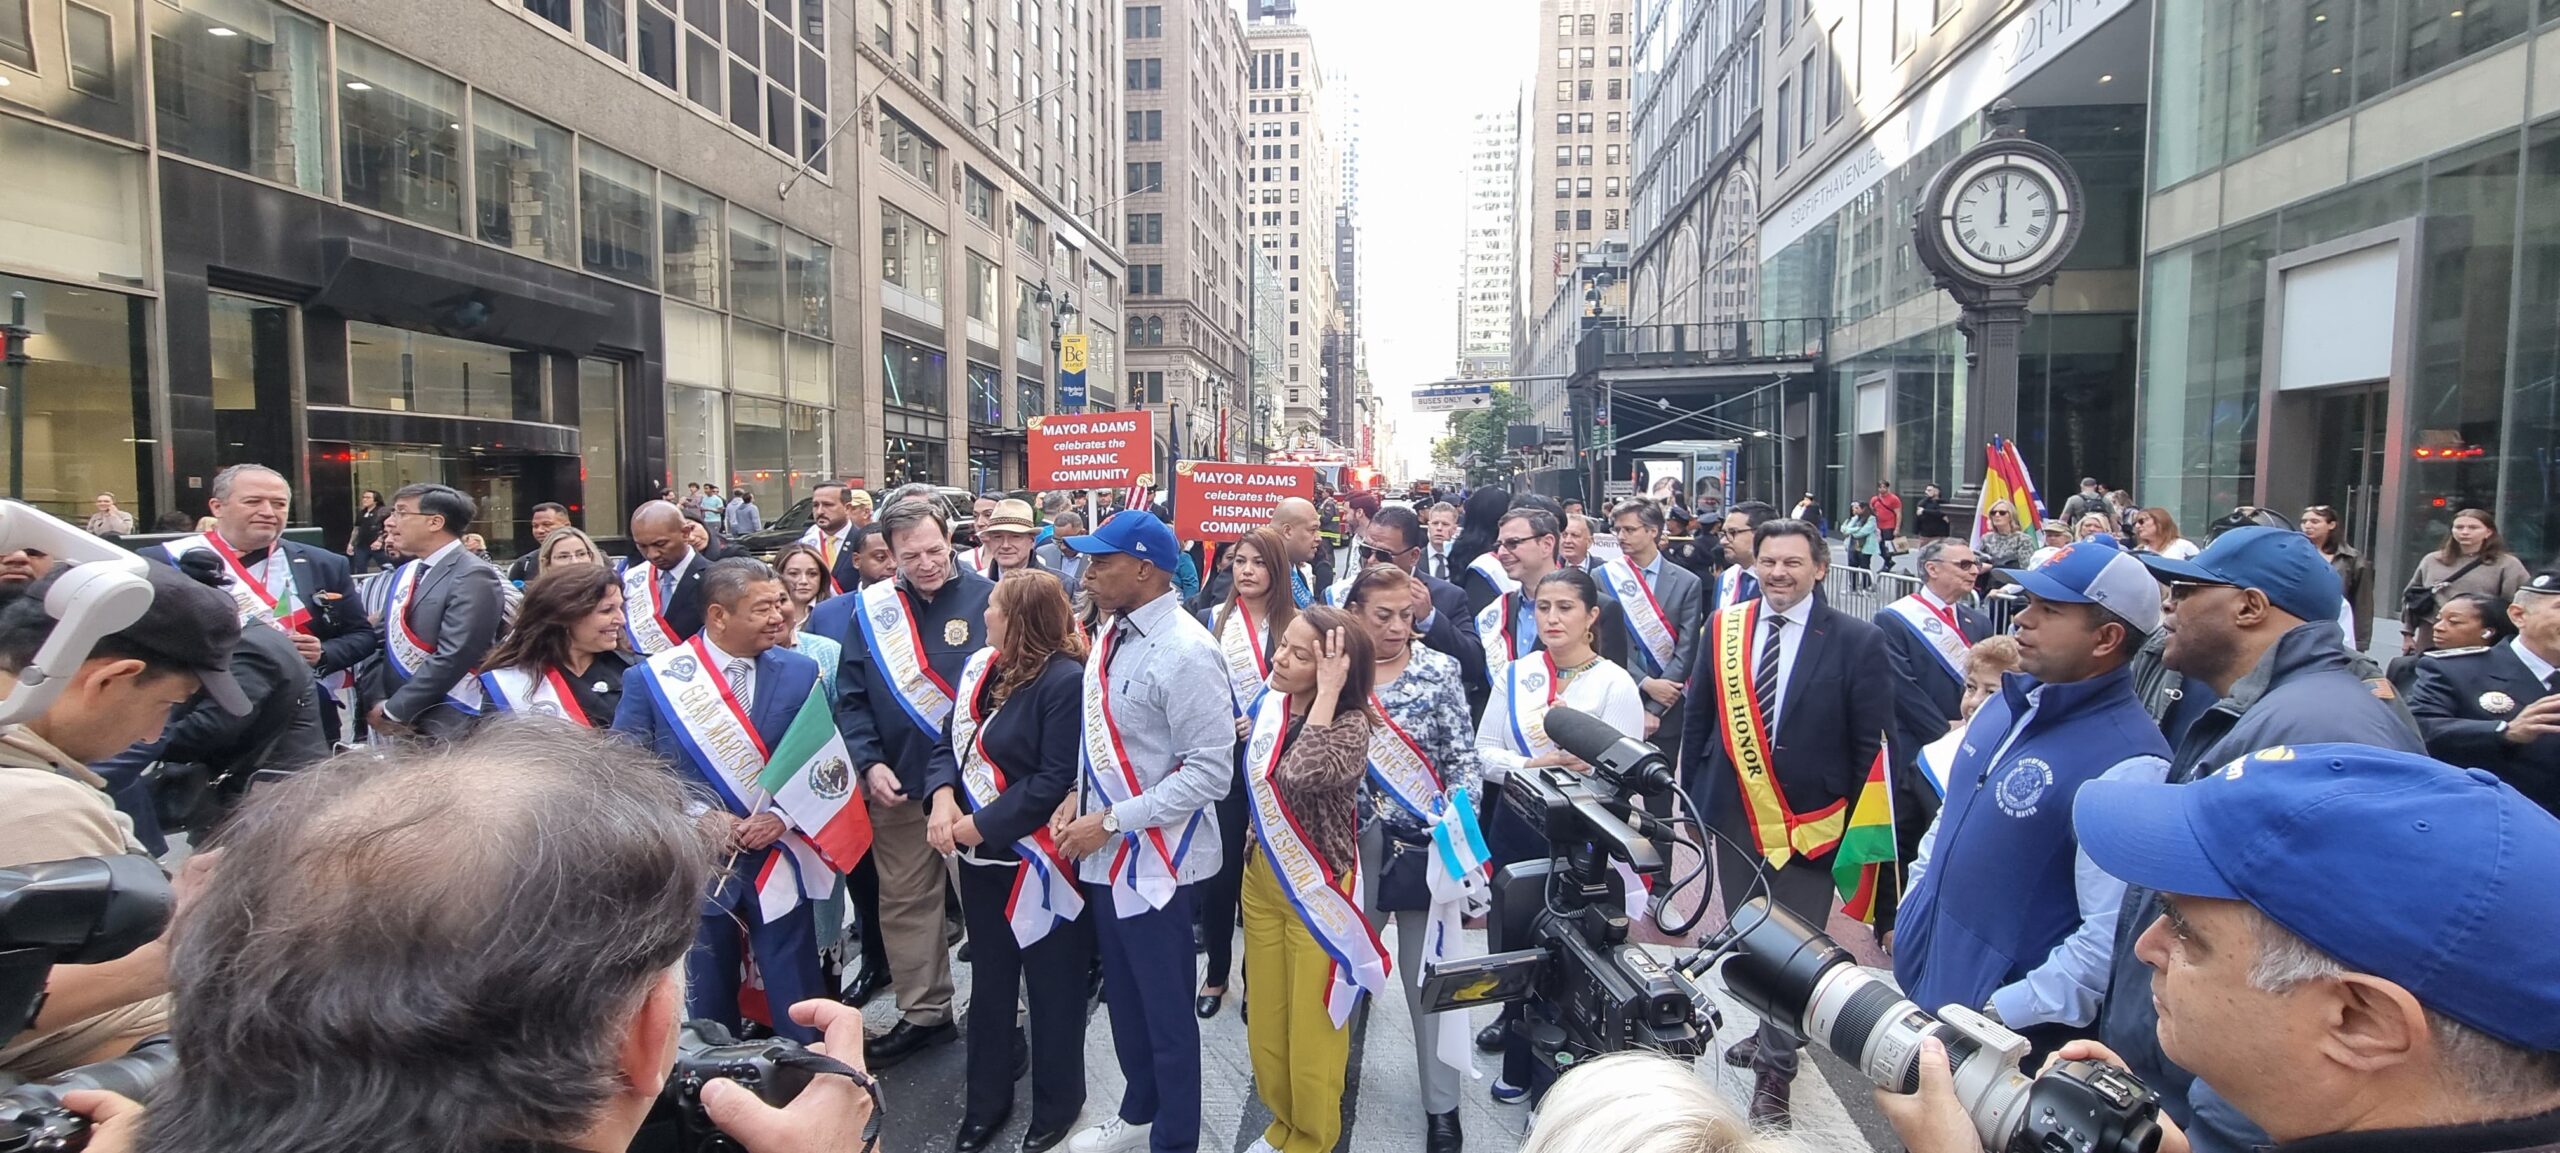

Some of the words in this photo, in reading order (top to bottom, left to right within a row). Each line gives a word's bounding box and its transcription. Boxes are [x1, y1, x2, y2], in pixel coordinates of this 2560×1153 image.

[1065, 346, 1084, 362] Be
[1042, 424, 1088, 436] MAYOR
[1090, 421, 1136, 434] ADAMS
[1054, 440, 1106, 451] celebrates
[1108, 438, 1126, 448] the
[1062, 453, 1118, 466] HISPANIC
[1052, 468, 1129, 482] COMMUNITY
[1193, 472, 1243, 484] MAYOR
[1247, 474, 1297, 487] ADAMS
[1204, 490, 1263, 501] celebrates
[1265, 492, 1284, 502] the
[1212, 506, 1274, 518] HISPANIC
[1200, 521, 1270, 533] COMMU
[885, 630, 923, 692] INVITADO
[917, 690, 945, 714] DE
[1728, 675, 1741, 702] DE
[1087, 688, 1110, 772] HONORARIO
[679, 684, 721, 725] GRAN
[705, 720, 763, 794] MARISCAL
[1733, 704, 1762, 779] HONOR
[1251, 764, 1281, 827] INVITADO
[1271, 829, 1316, 892] ESPECIAL
